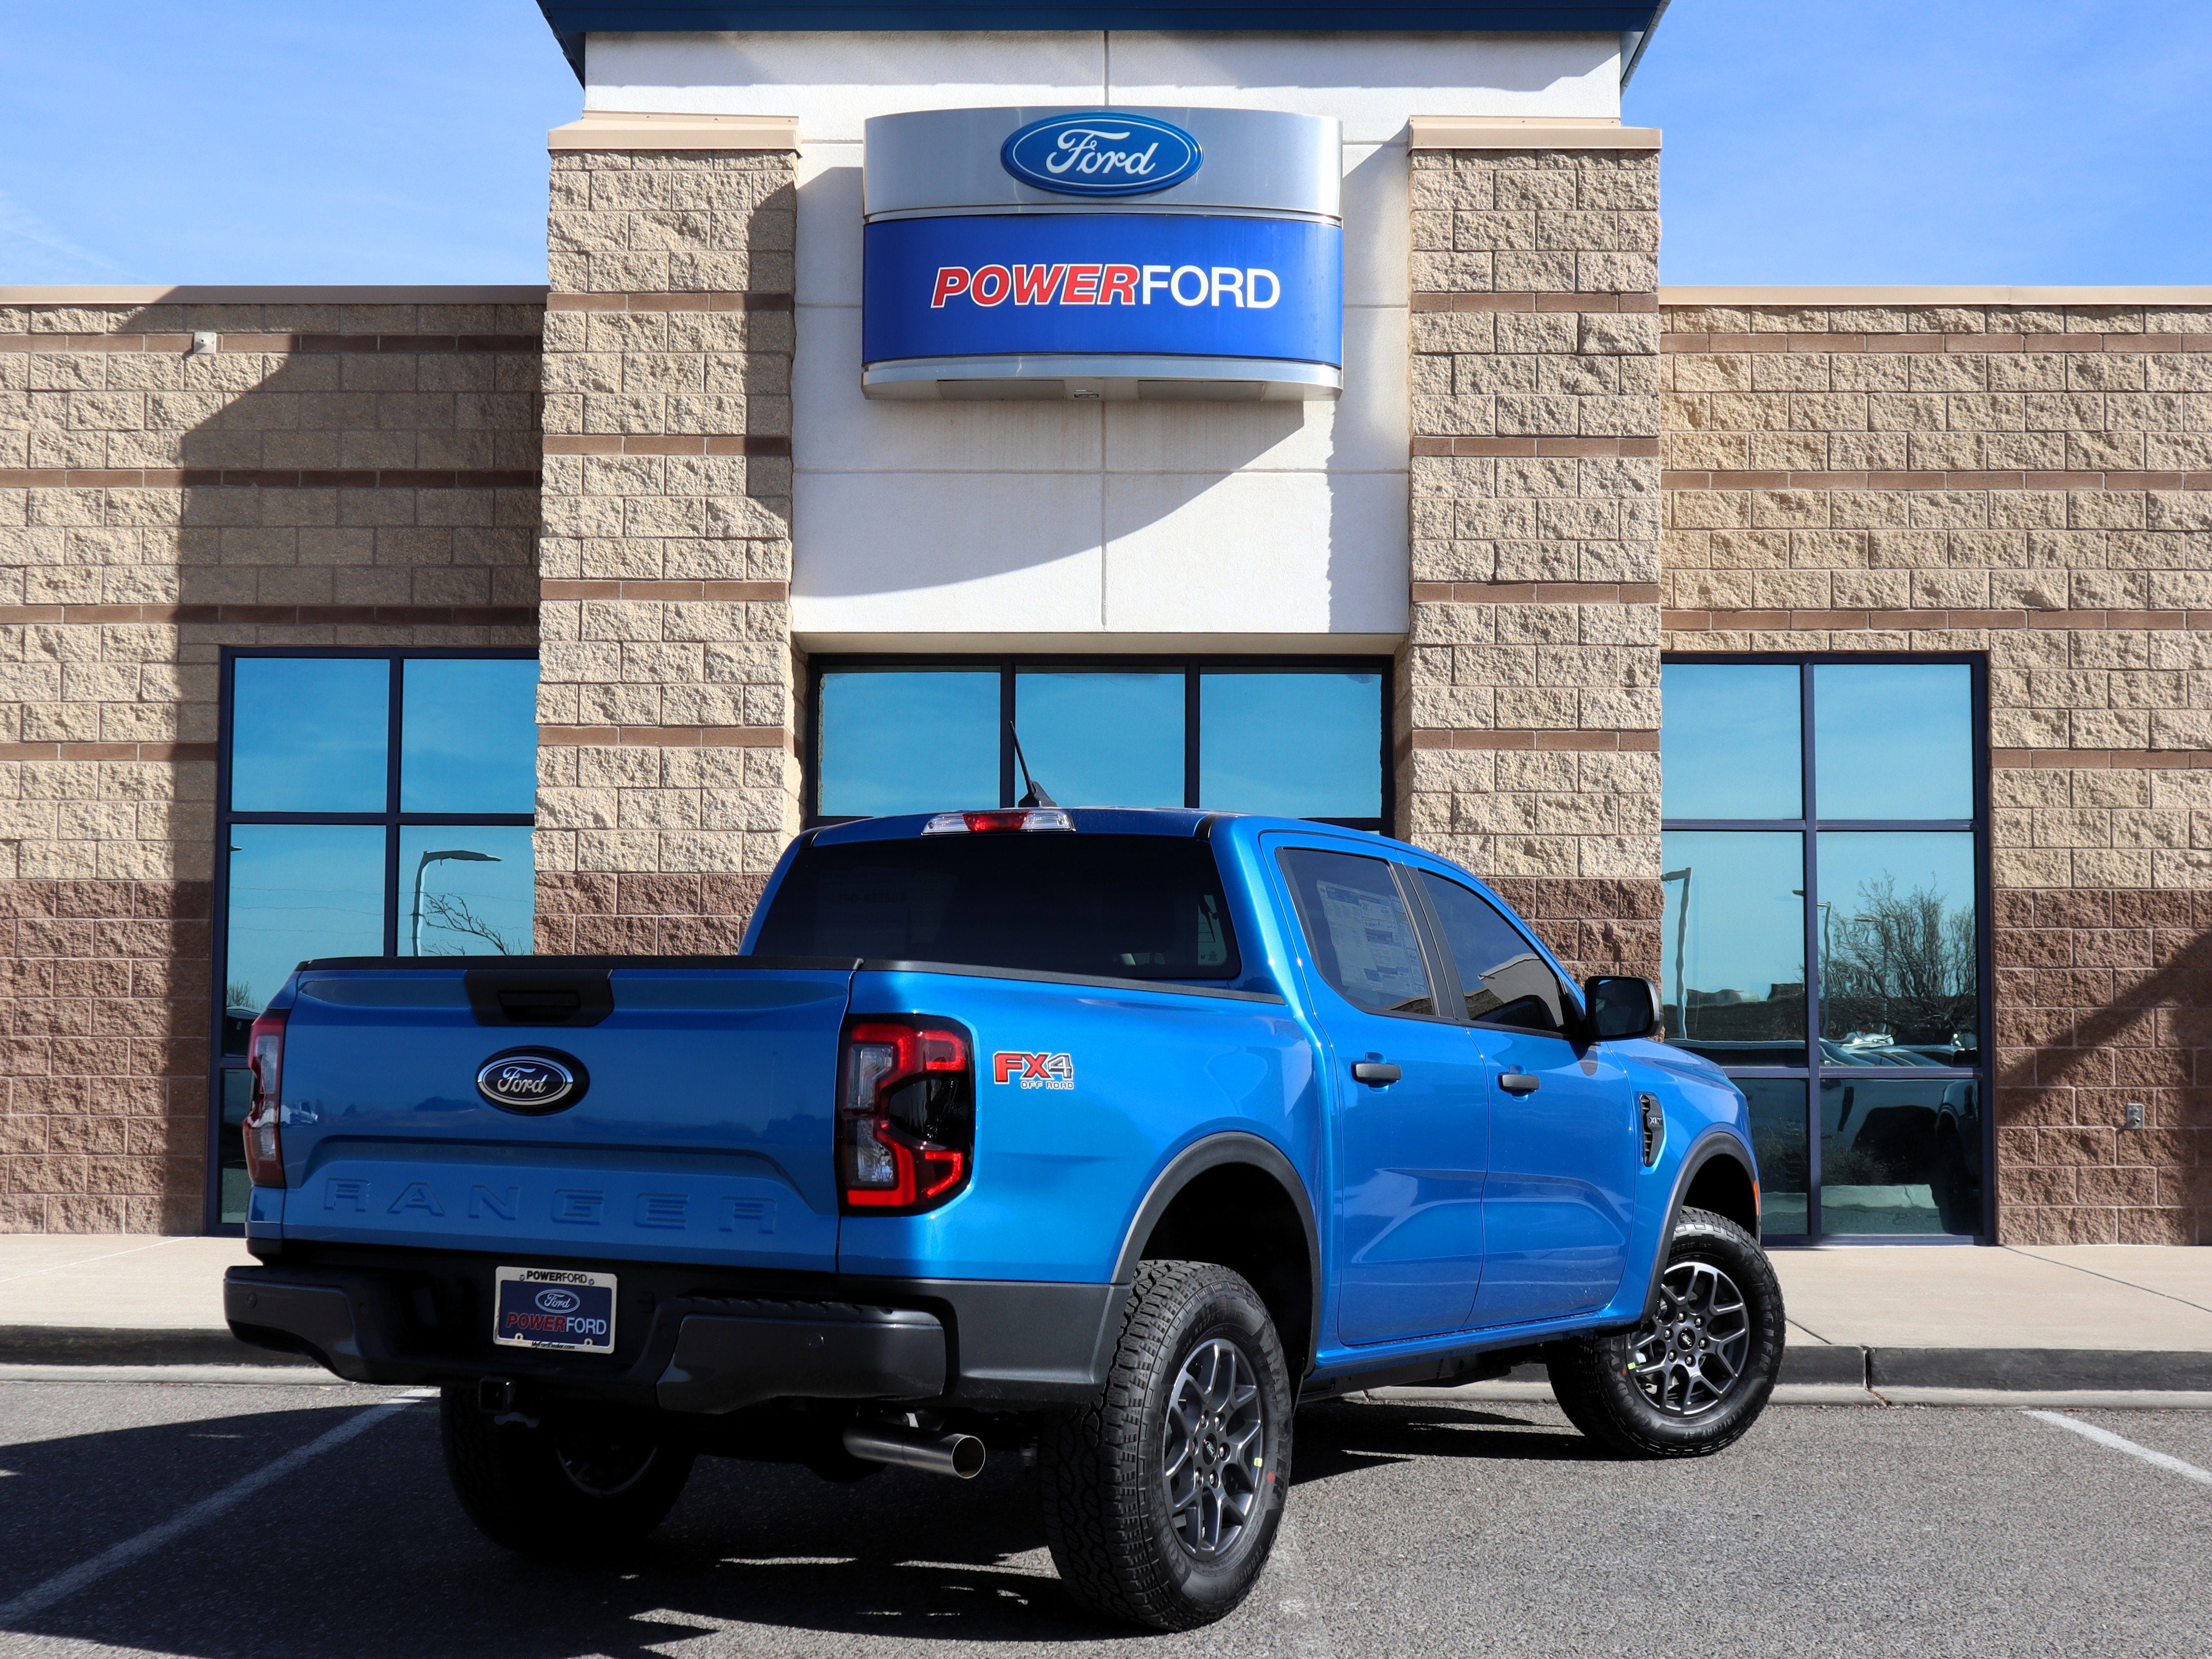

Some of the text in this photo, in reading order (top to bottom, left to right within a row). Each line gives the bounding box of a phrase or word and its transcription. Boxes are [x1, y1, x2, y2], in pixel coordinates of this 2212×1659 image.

[1046, 128, 1158, 175] Ford
[930, 263, 1281, 309] POWERFORD
[497, 1066, 548, 1093] Ford
[993, 1051, 1073, 1084] FX4
[1020, 1081, 1074, 1090] OFF ROAD
[324, 1176, 777, 1235] RANGER
[526, 1270, 588, 1284] POWERFORD
[544, 1293, 571, 1309] Ford
[506, 1312, 607, 1335] POWERFORD
